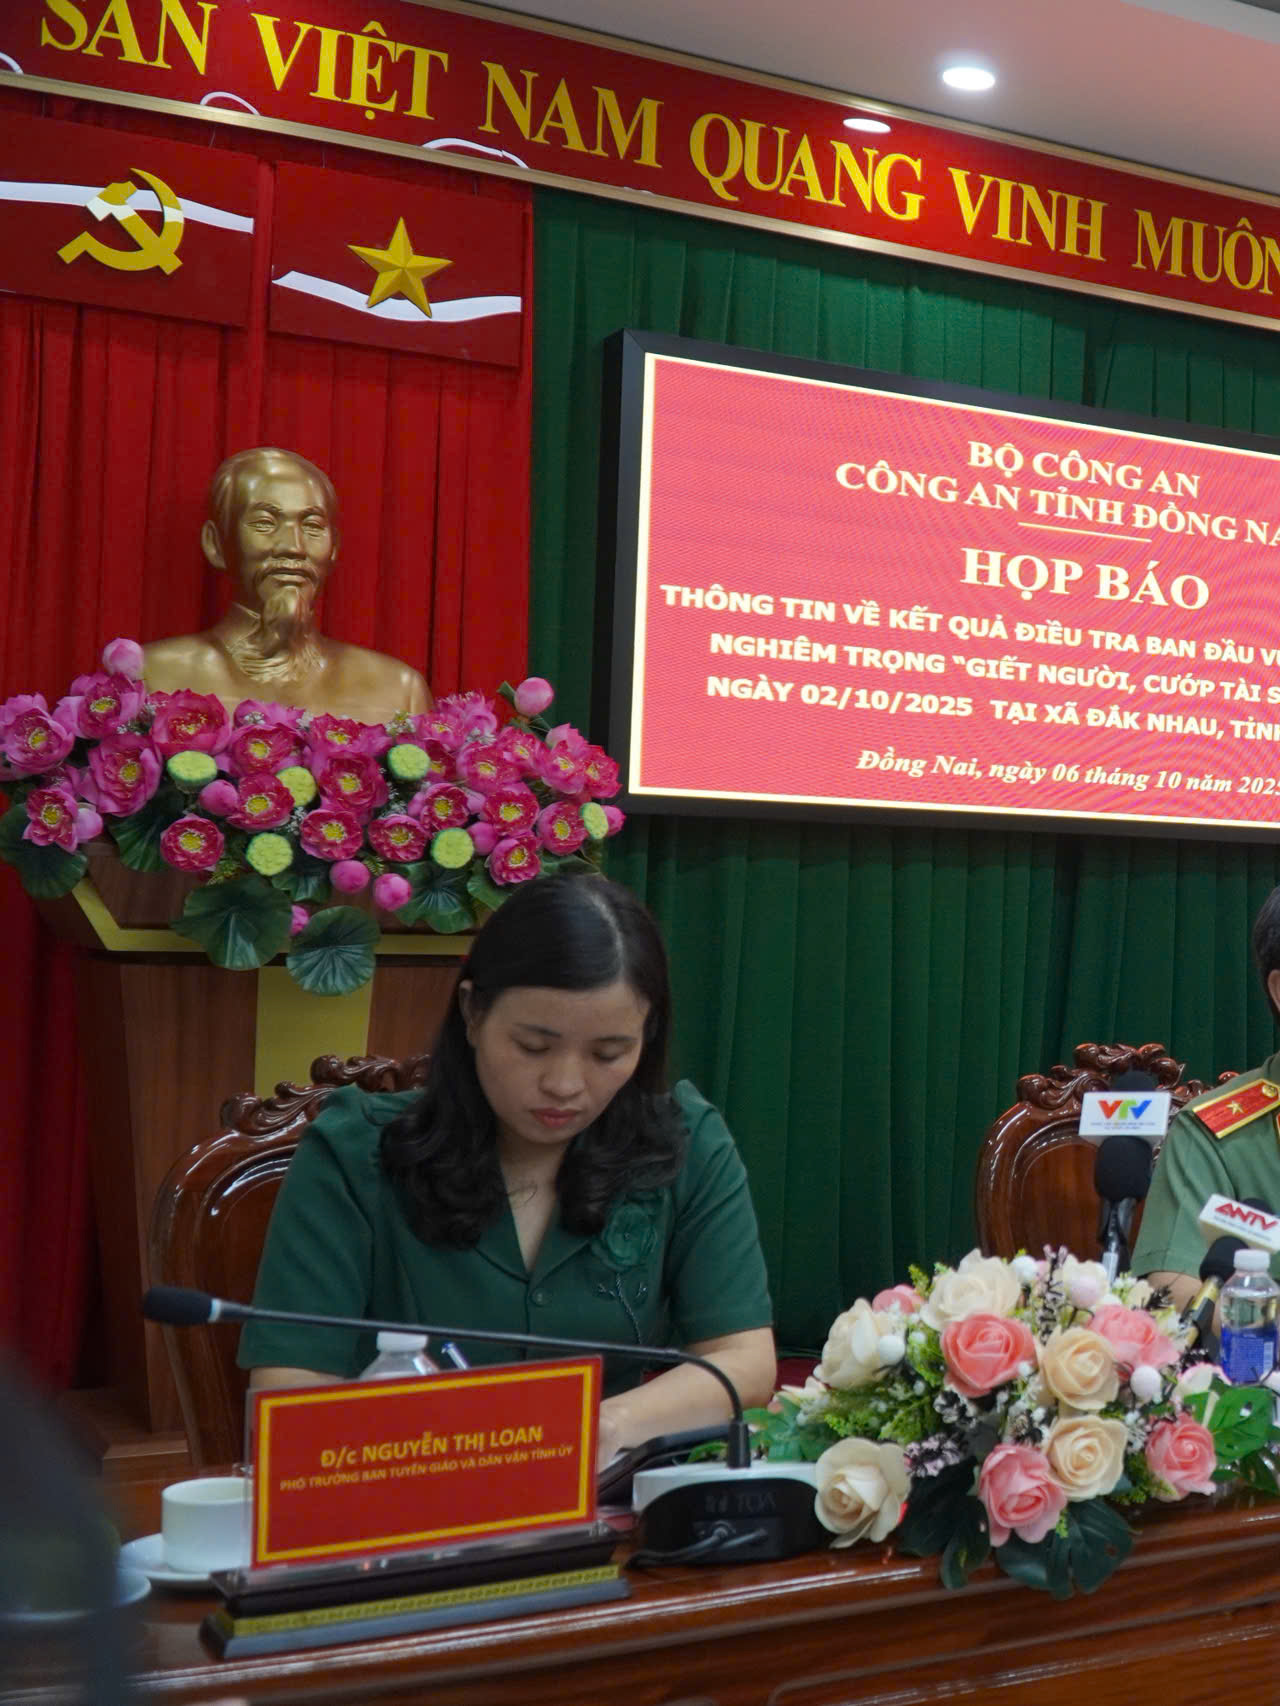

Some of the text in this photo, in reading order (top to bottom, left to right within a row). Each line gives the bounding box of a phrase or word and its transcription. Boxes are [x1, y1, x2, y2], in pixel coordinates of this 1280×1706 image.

[251, 13, 449, 120] VIỆT
[480, 60, 664, 169] NAM
[689, 112, 925, 222] QUANG
[947, 167, 1106, 261] VINH
[968, 441, 1200, 498] BỘ CÔNG AN
[836, 460, 958, 502] CÔNG
[965, 483, 1020, 509] AN
[1030, 486, 1124, 526] TỈNH
[1133, 501, 1238, 539] ĐỒNG
[960, 548, 1210, 610] HỌP BÁO
[660, 583, 774, 615] THÔNG
[780, 597, 835, 624] TIN
[843, 600, 881, 627] VỀ
[889, 605, 942, 632] KẾT
[949, 609, 1008, 641] QUẢ
[1014, 619, 1081, 646] ĐIỀU
[1088, 630, 1139, 653] TRA
[1146, 636, 1196, 658] BAN
[1203, 638, 1255, 664] ĐẦU
[710, 633, 836, 664] NGHIÊM
[843, 645, 945, 674] TRỌNG
[1038, 664, 1136, 694] NGƯỜI,
[1144, 671, 1215, 698] CƯỚP
[1219, 678, 1261, 704] TÀI
[707, 674, 794, 702] NGÀY
[800, 684, 973, 717] 02/10/2025
[990, 699, 1036, 726] TẠI
[1044, 703, 1078, 725] XÃ
[1086, 705, 1139, 731] ĐẮK
[1147, 715, 1224, 740] NHAU,
[857, 746, 927, 778] Đồng
[930, 755, 983, 780] Nai,
[989, 762, 1046, 785] ngày
[1052, 764, 1078, 784] 06
[1085, 765, 1149, 792] tháng
[1155, 771, 1181, 789] 10
[1187, 772, 1231, 793] năm
[1098, 1099, 1152, 1120] VTV
[1215, 1203, 1278, 1231] ANTV
[321, 1425, 543, 1469] Đ/c NGUYỄN THỊ LOAN
[362, 1468, 386, 1481] BAN
